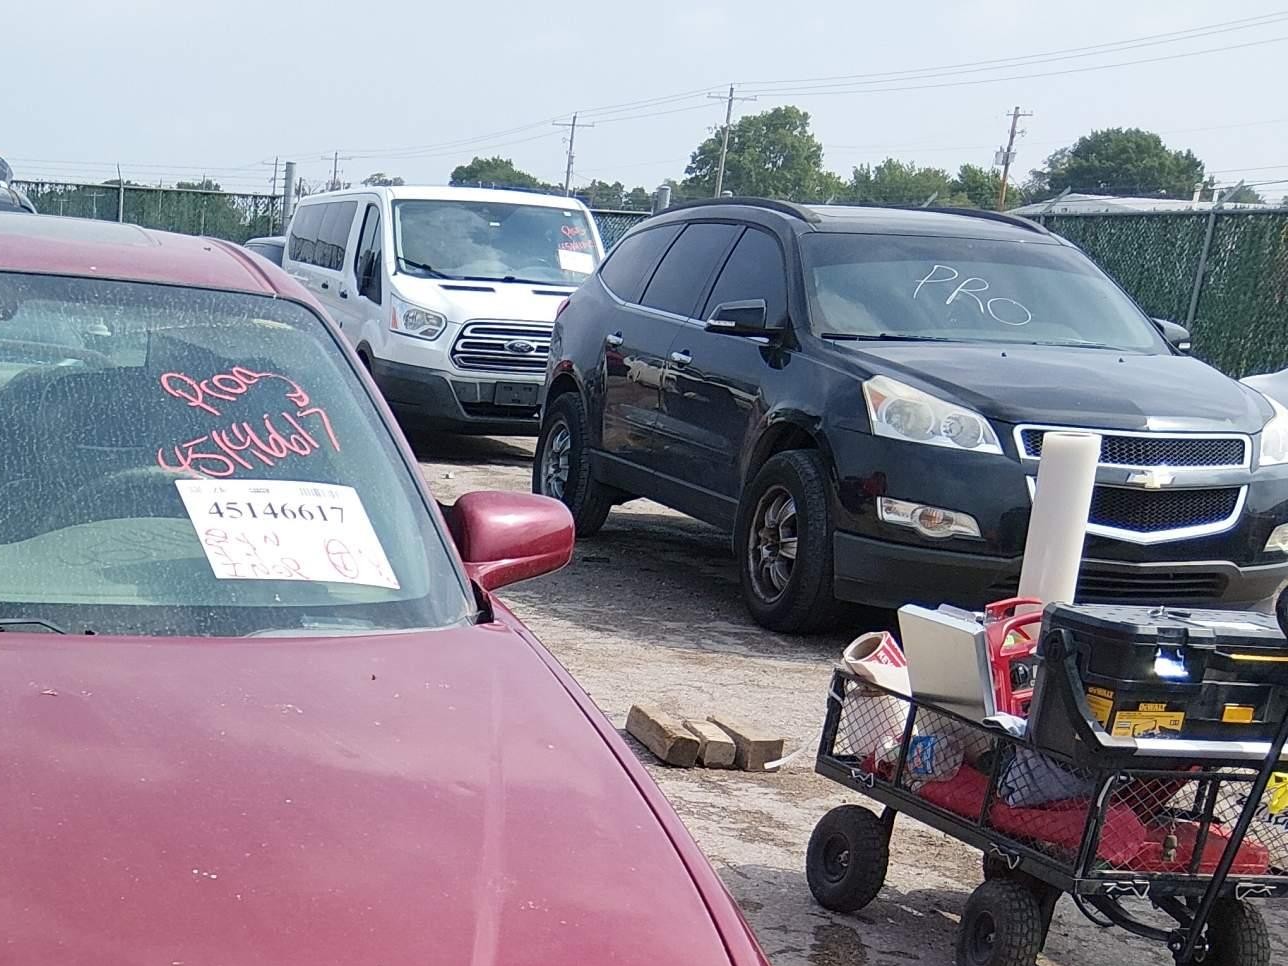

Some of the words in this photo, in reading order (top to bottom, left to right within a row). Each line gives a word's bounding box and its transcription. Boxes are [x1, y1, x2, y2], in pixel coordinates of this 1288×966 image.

[913, 265, 1032, 326] PRO
[157, 407, 341, 479] 45146617
[208, 501, 344, 523] 45146617
